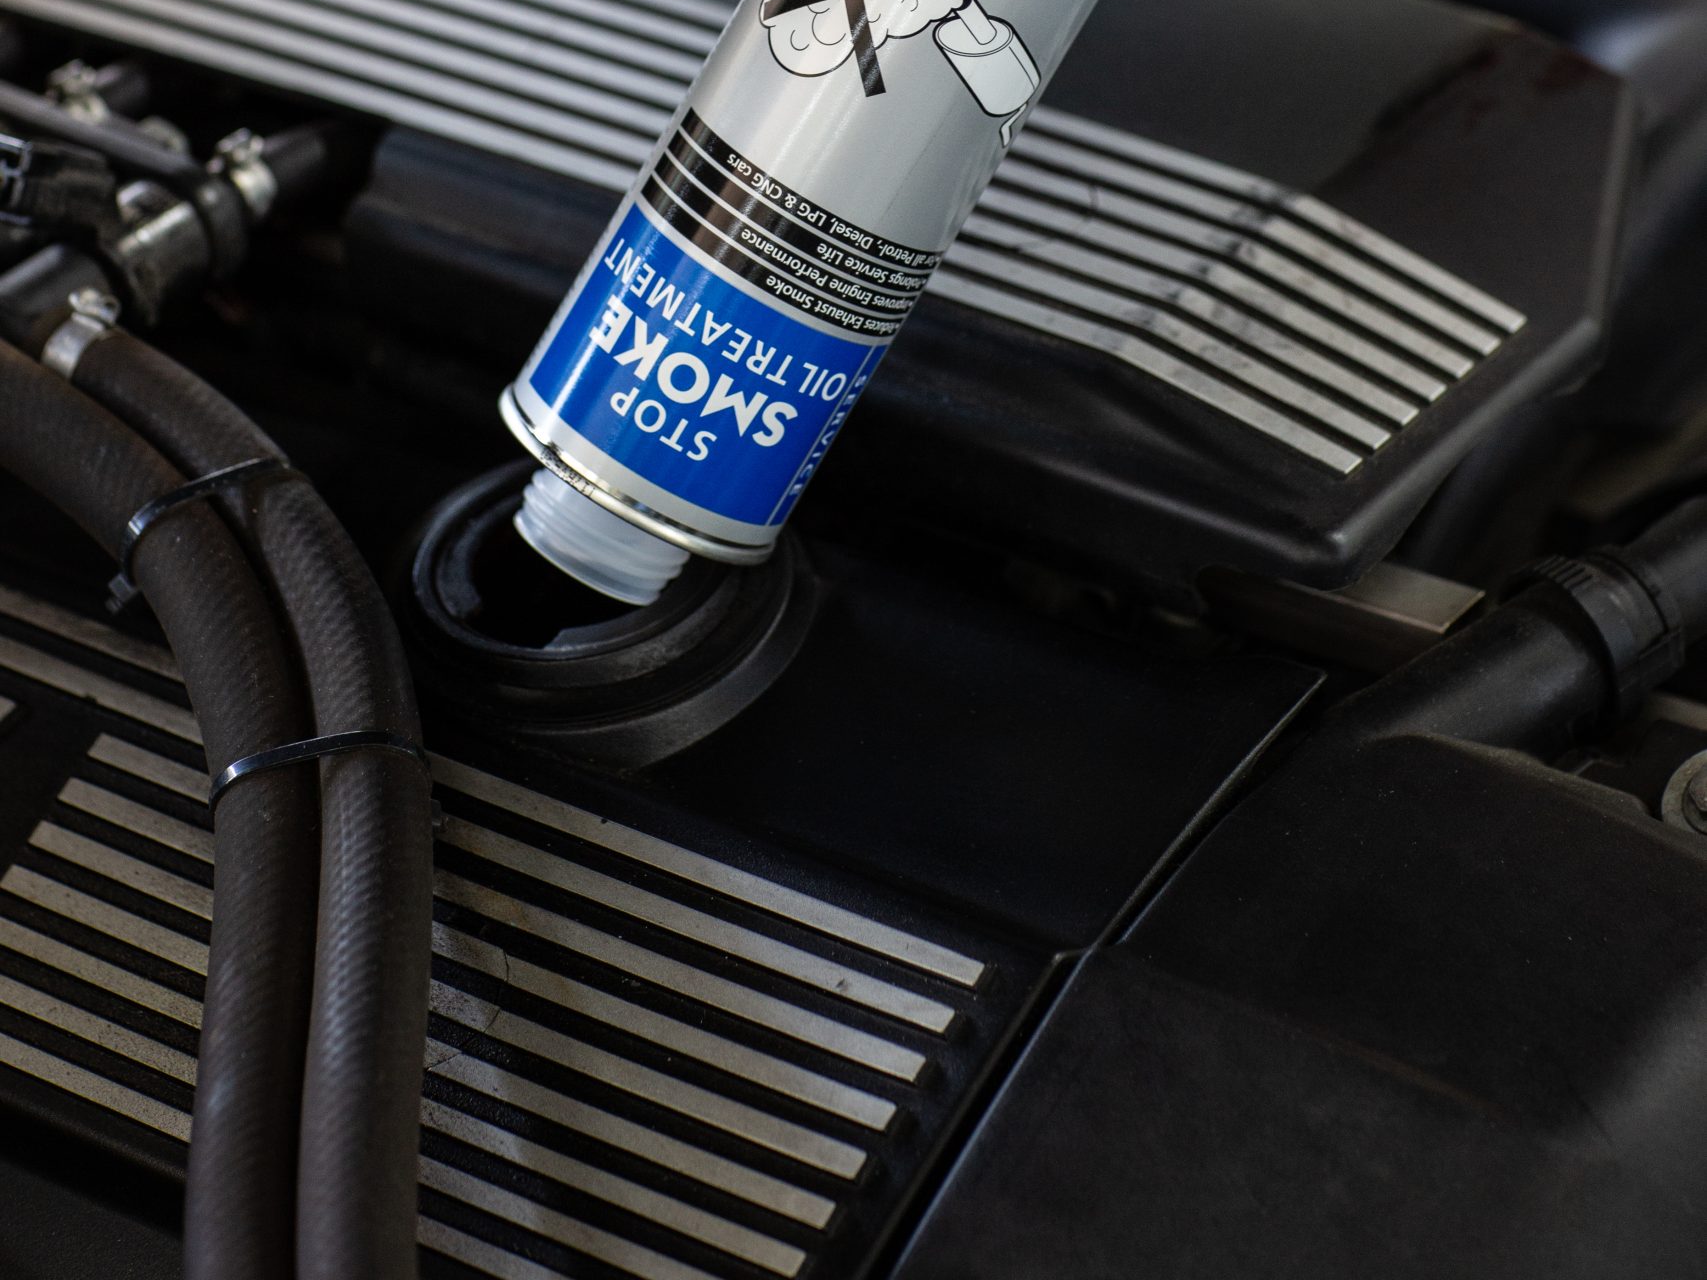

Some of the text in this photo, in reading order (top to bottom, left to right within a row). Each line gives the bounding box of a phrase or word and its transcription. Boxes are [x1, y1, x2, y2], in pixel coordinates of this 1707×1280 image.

[727, 154, 753, 176] cars
[751, 173, 783, 200] CNG
[784, 193, 798, 208] &
[797, 203, 827, 227] LPG
[829, 216, 874, 249] Diesel,
[741, 228, 829, 287] Performance
[817, 242, 844, 263] Life
[844, 257, 888, 283] Service
[766, 274, 814, 306] Smoke
[829, 278, 873, 305] Engine
[604, 238, 793, 386] TREATMENT
[814, 303, 863, 329] Exhaust
[589, 294, 798, 447] SMOKE
[798, 361, 847, 401] OIL
[609, 386, 718, 461] STOP
[791, 374, 867, 495] SERVICE
